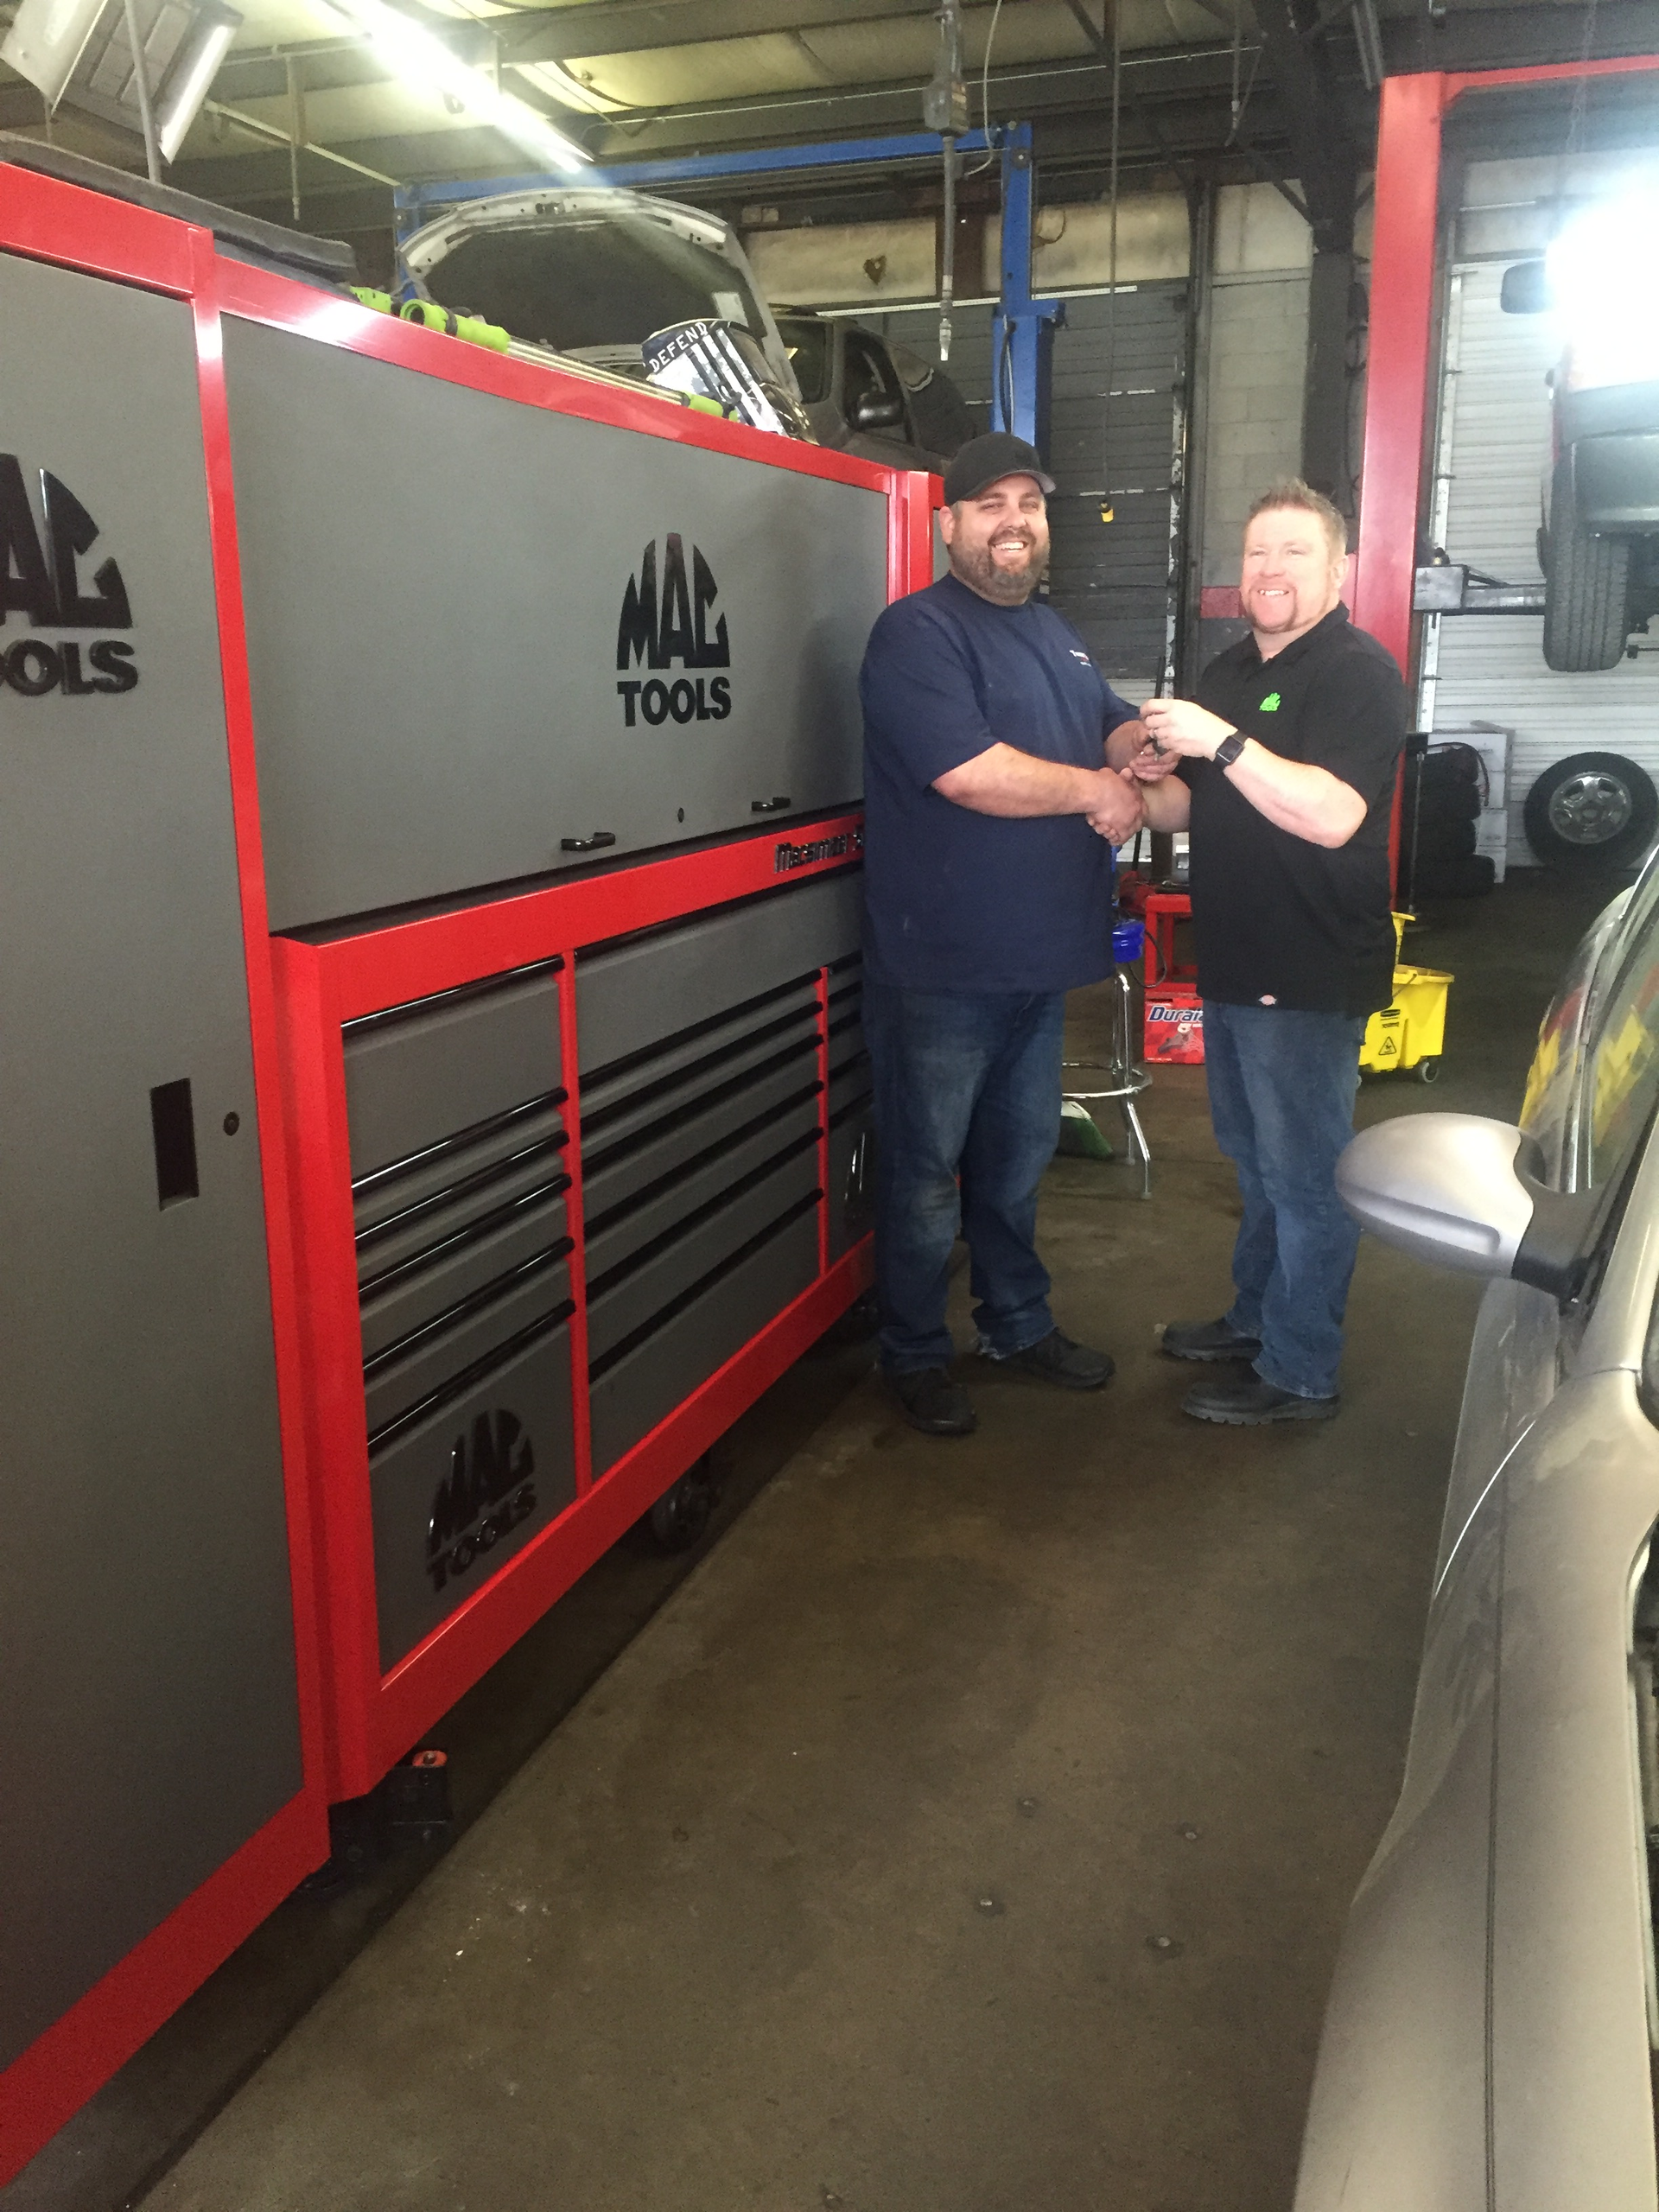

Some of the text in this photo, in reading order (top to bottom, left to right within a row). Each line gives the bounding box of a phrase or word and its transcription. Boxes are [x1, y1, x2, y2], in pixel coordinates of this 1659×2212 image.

[648, 321, 709, 373] DEFEND
[0, 453, 133, 629] AC
[616, 532, 730, 671] MAC
[0, 639, 138, 696] OLS
[616, 677, 732, 727] TOOLS
[427, 1408, 535, 1557] MAC
[427, 1483, 537, 1592] TOOLS
